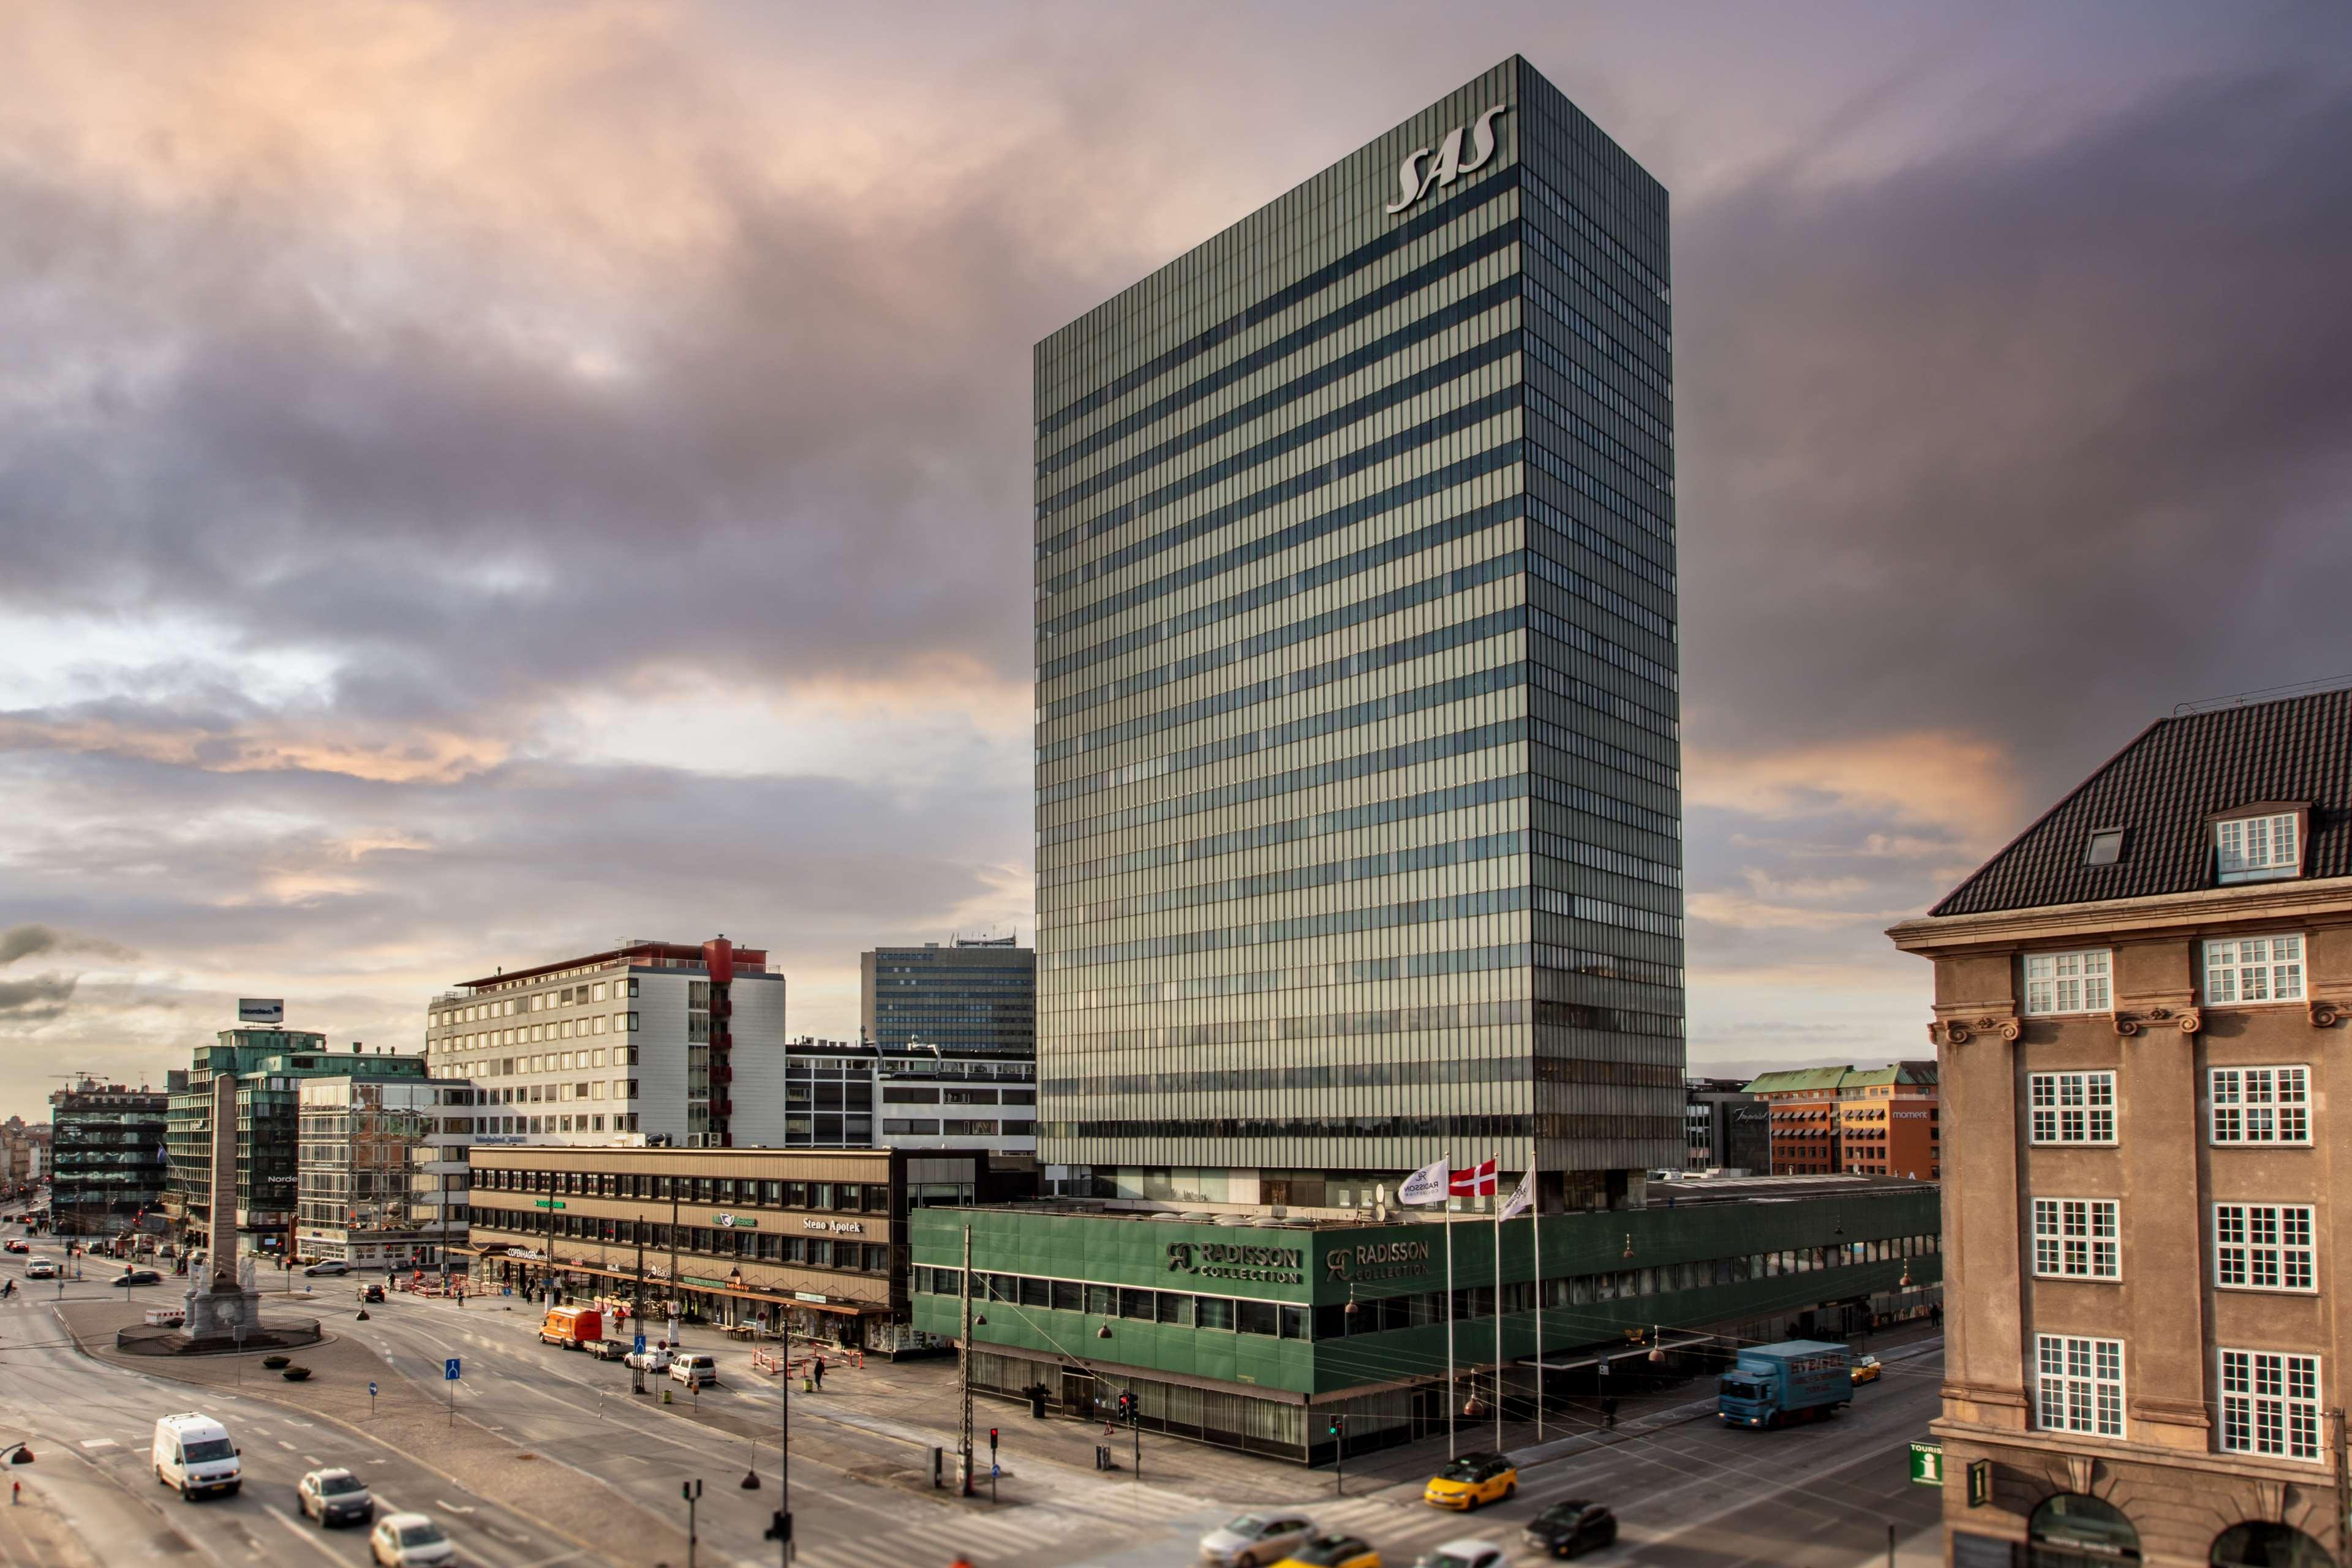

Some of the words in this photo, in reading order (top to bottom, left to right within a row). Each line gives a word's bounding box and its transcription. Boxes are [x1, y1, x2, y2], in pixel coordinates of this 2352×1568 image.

[1386, 105, 1506, 213] SAS
[1893, 1110, 1928, 1118] moment
[804, 1218, 826, 1229] Steno
[829, 1220, 860, 1234] Apotek
[508, 1248, 538, 1260] COPENHAGEN
[1201, 1242, 1301, 1268] RADISSON
[1357, 1240, 1429, 1265] RADISSON
[1200, 1265, 1299, 1284] COLLECTION
[1355, 1264, 1430, 1281] COLLECTION
[1911, 1444, 1942, 1454] TOURIS
